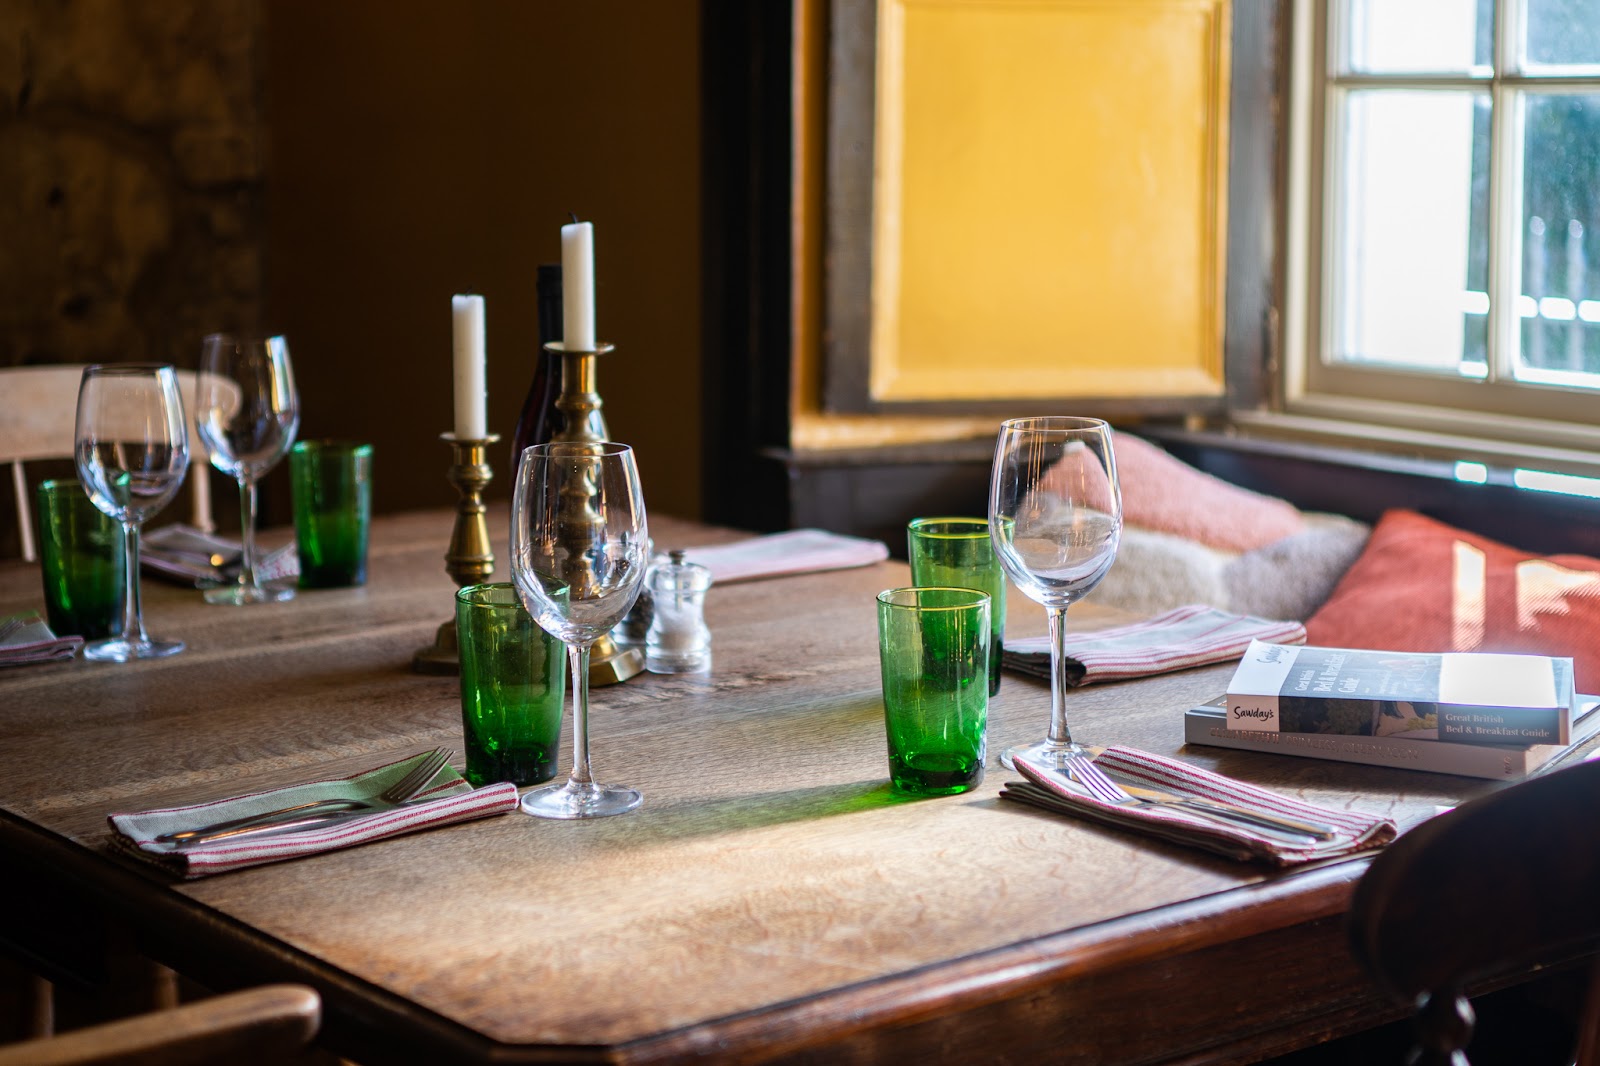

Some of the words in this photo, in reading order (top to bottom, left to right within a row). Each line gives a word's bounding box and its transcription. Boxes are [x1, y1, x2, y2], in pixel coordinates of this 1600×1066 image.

[1319, 653, 1347, 677] Breakfast
[1312, 680, 1335, 692] Bed
[1338, 677, 1361, 693] Guide
[1233, 706, 1275, 722] Sawday's
[1445, 713, 1471, 722] Great
[1473, 714, 1504, 723] British
[1446, 725, 1463, 734] Bed
[1476, 727, 1519, 736] Breakfast
[1522, 729, 1550, 738] Guide
